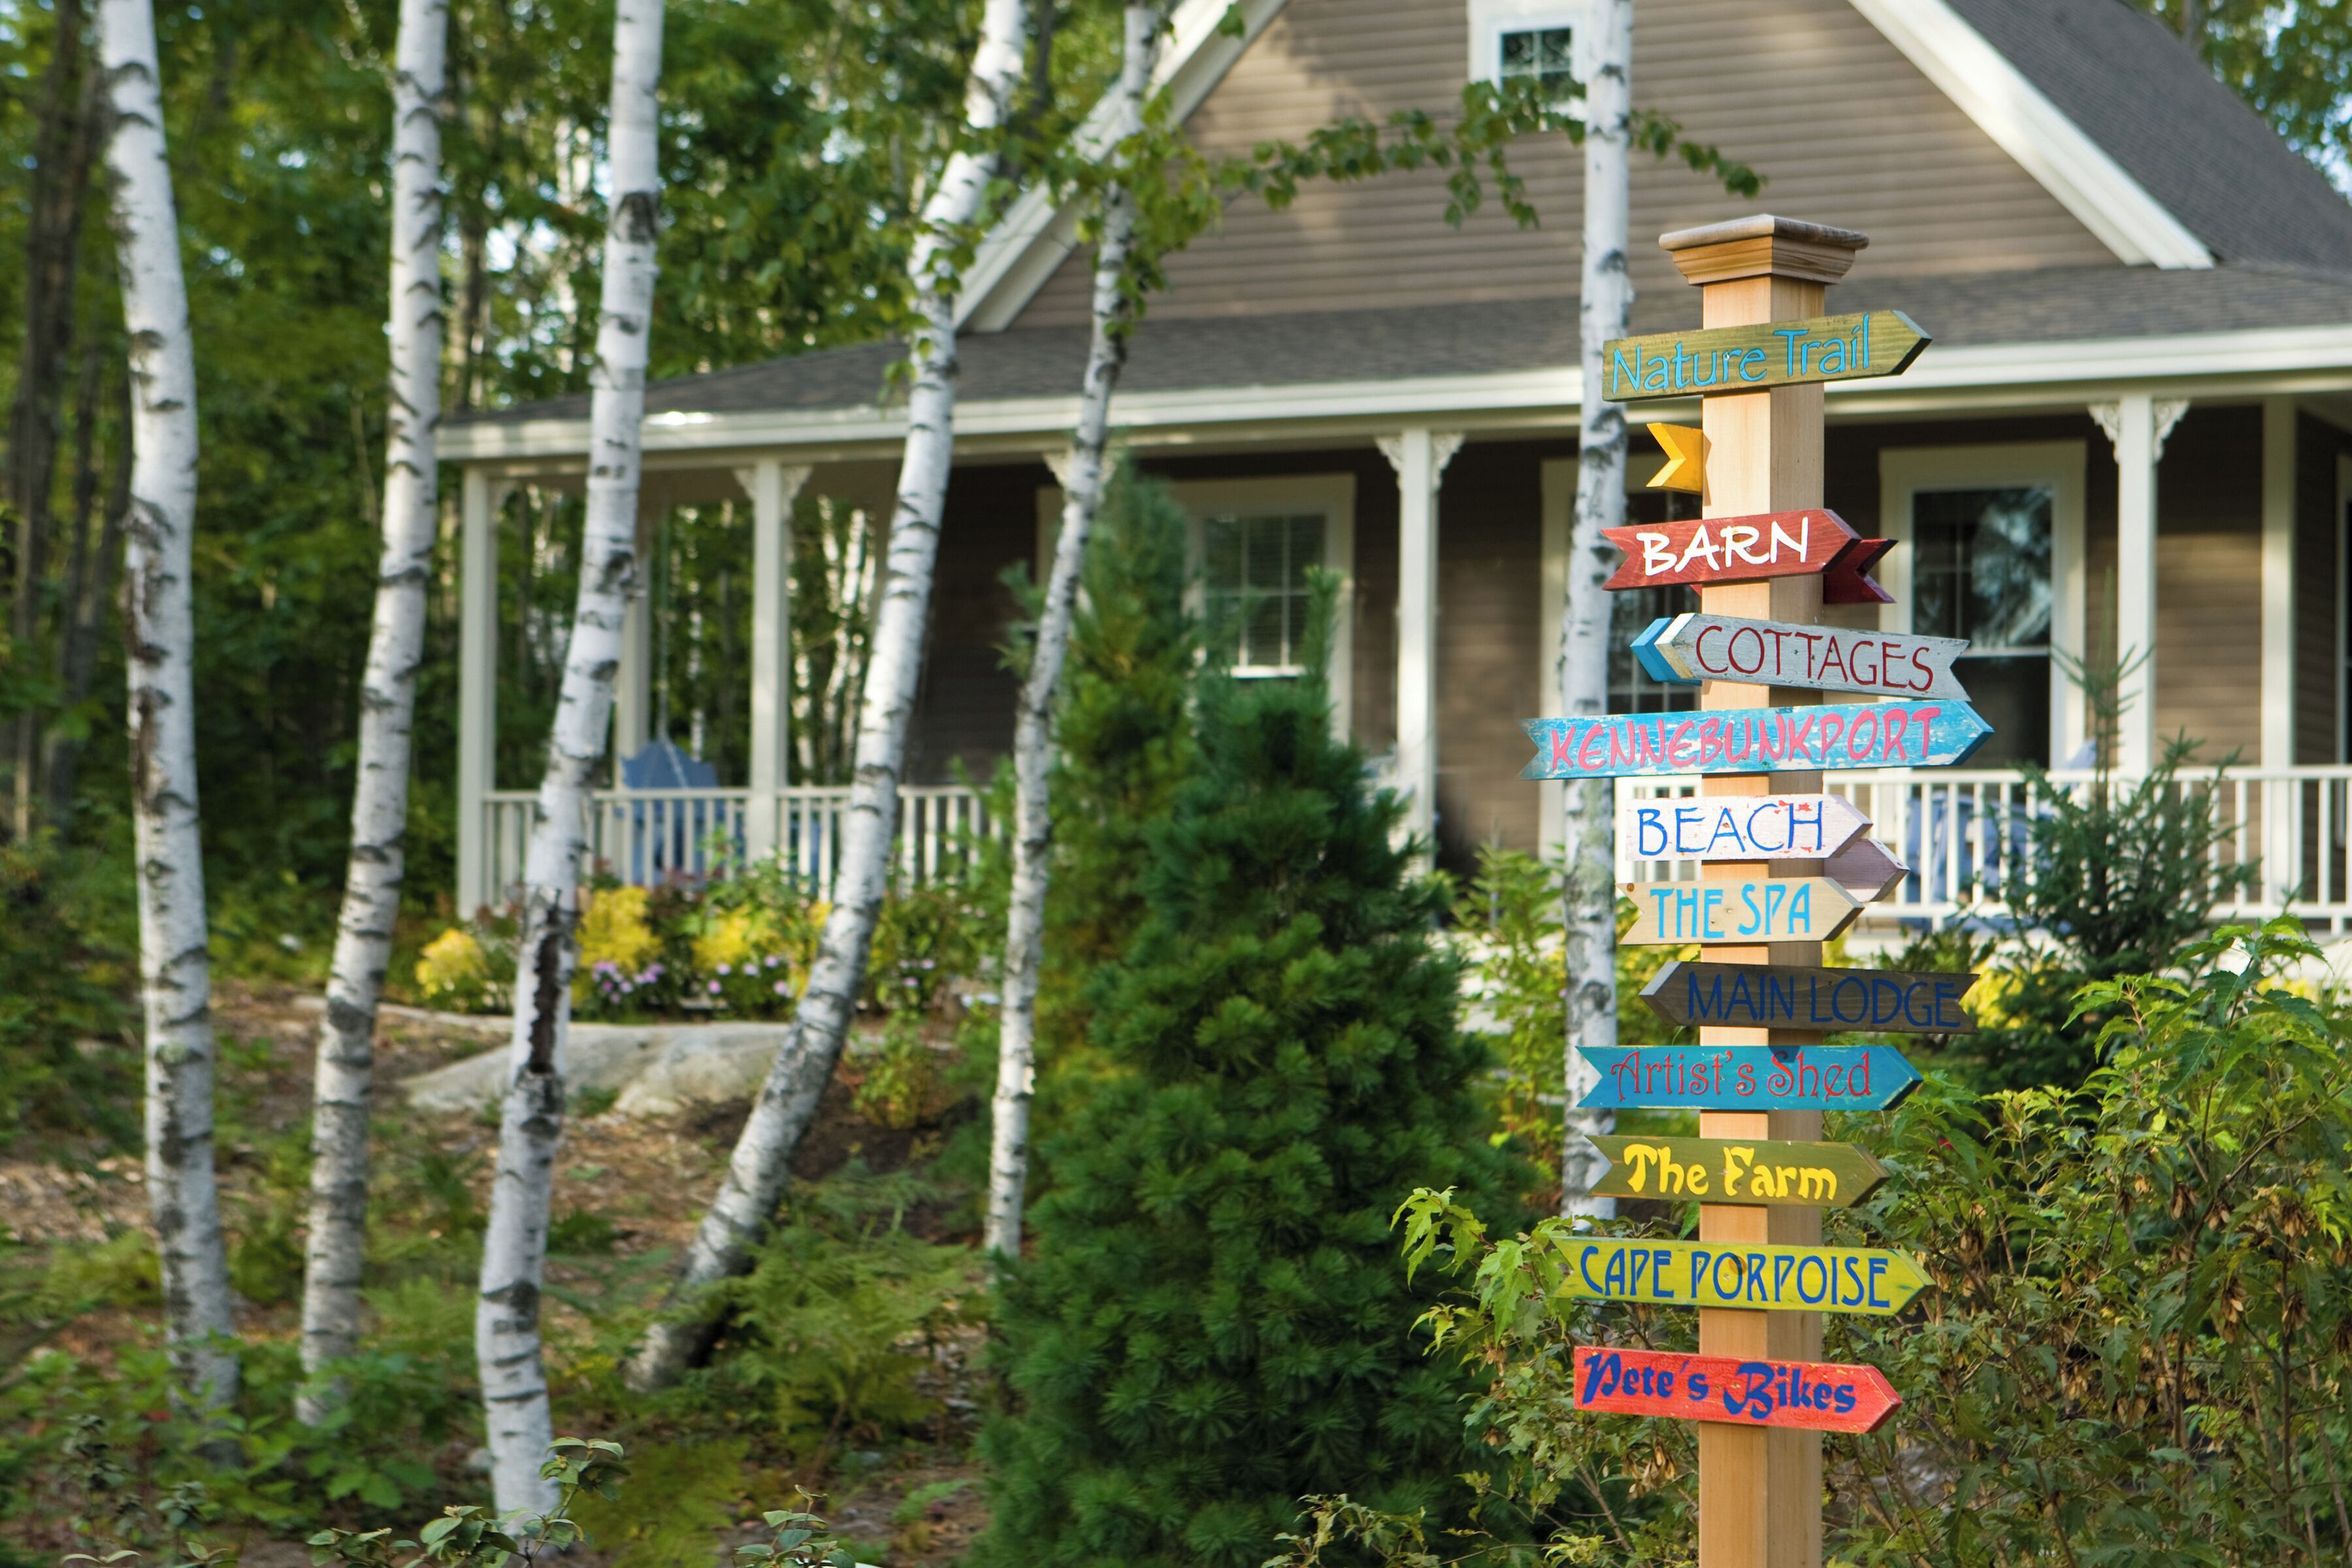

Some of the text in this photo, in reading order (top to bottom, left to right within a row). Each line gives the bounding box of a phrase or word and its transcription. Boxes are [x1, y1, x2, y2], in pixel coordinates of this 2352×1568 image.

[1612, 314, 1870, 393] Nature Trail
[1637, 517, 1809, 576] BARN
[1695, 625, 1934, 692] COTTAGES
[1551, 707, 1942, 770] KENNEBUNKPORT
[1637, 800, 1823, 856] BEACH
[1650, 883, 1811, 939] THE SPA
[1688, 972, 1961, 1028] MAIN LODGE
[1610, 1051, 1872, 1102] Artist's Shed
[1624, 1143, 1838, 1200] The Farm
[1580, 1245, 1890, 1308] CAPE PORPOISE
[1582, 1352, 1857, 1420] Pete's Bikes
